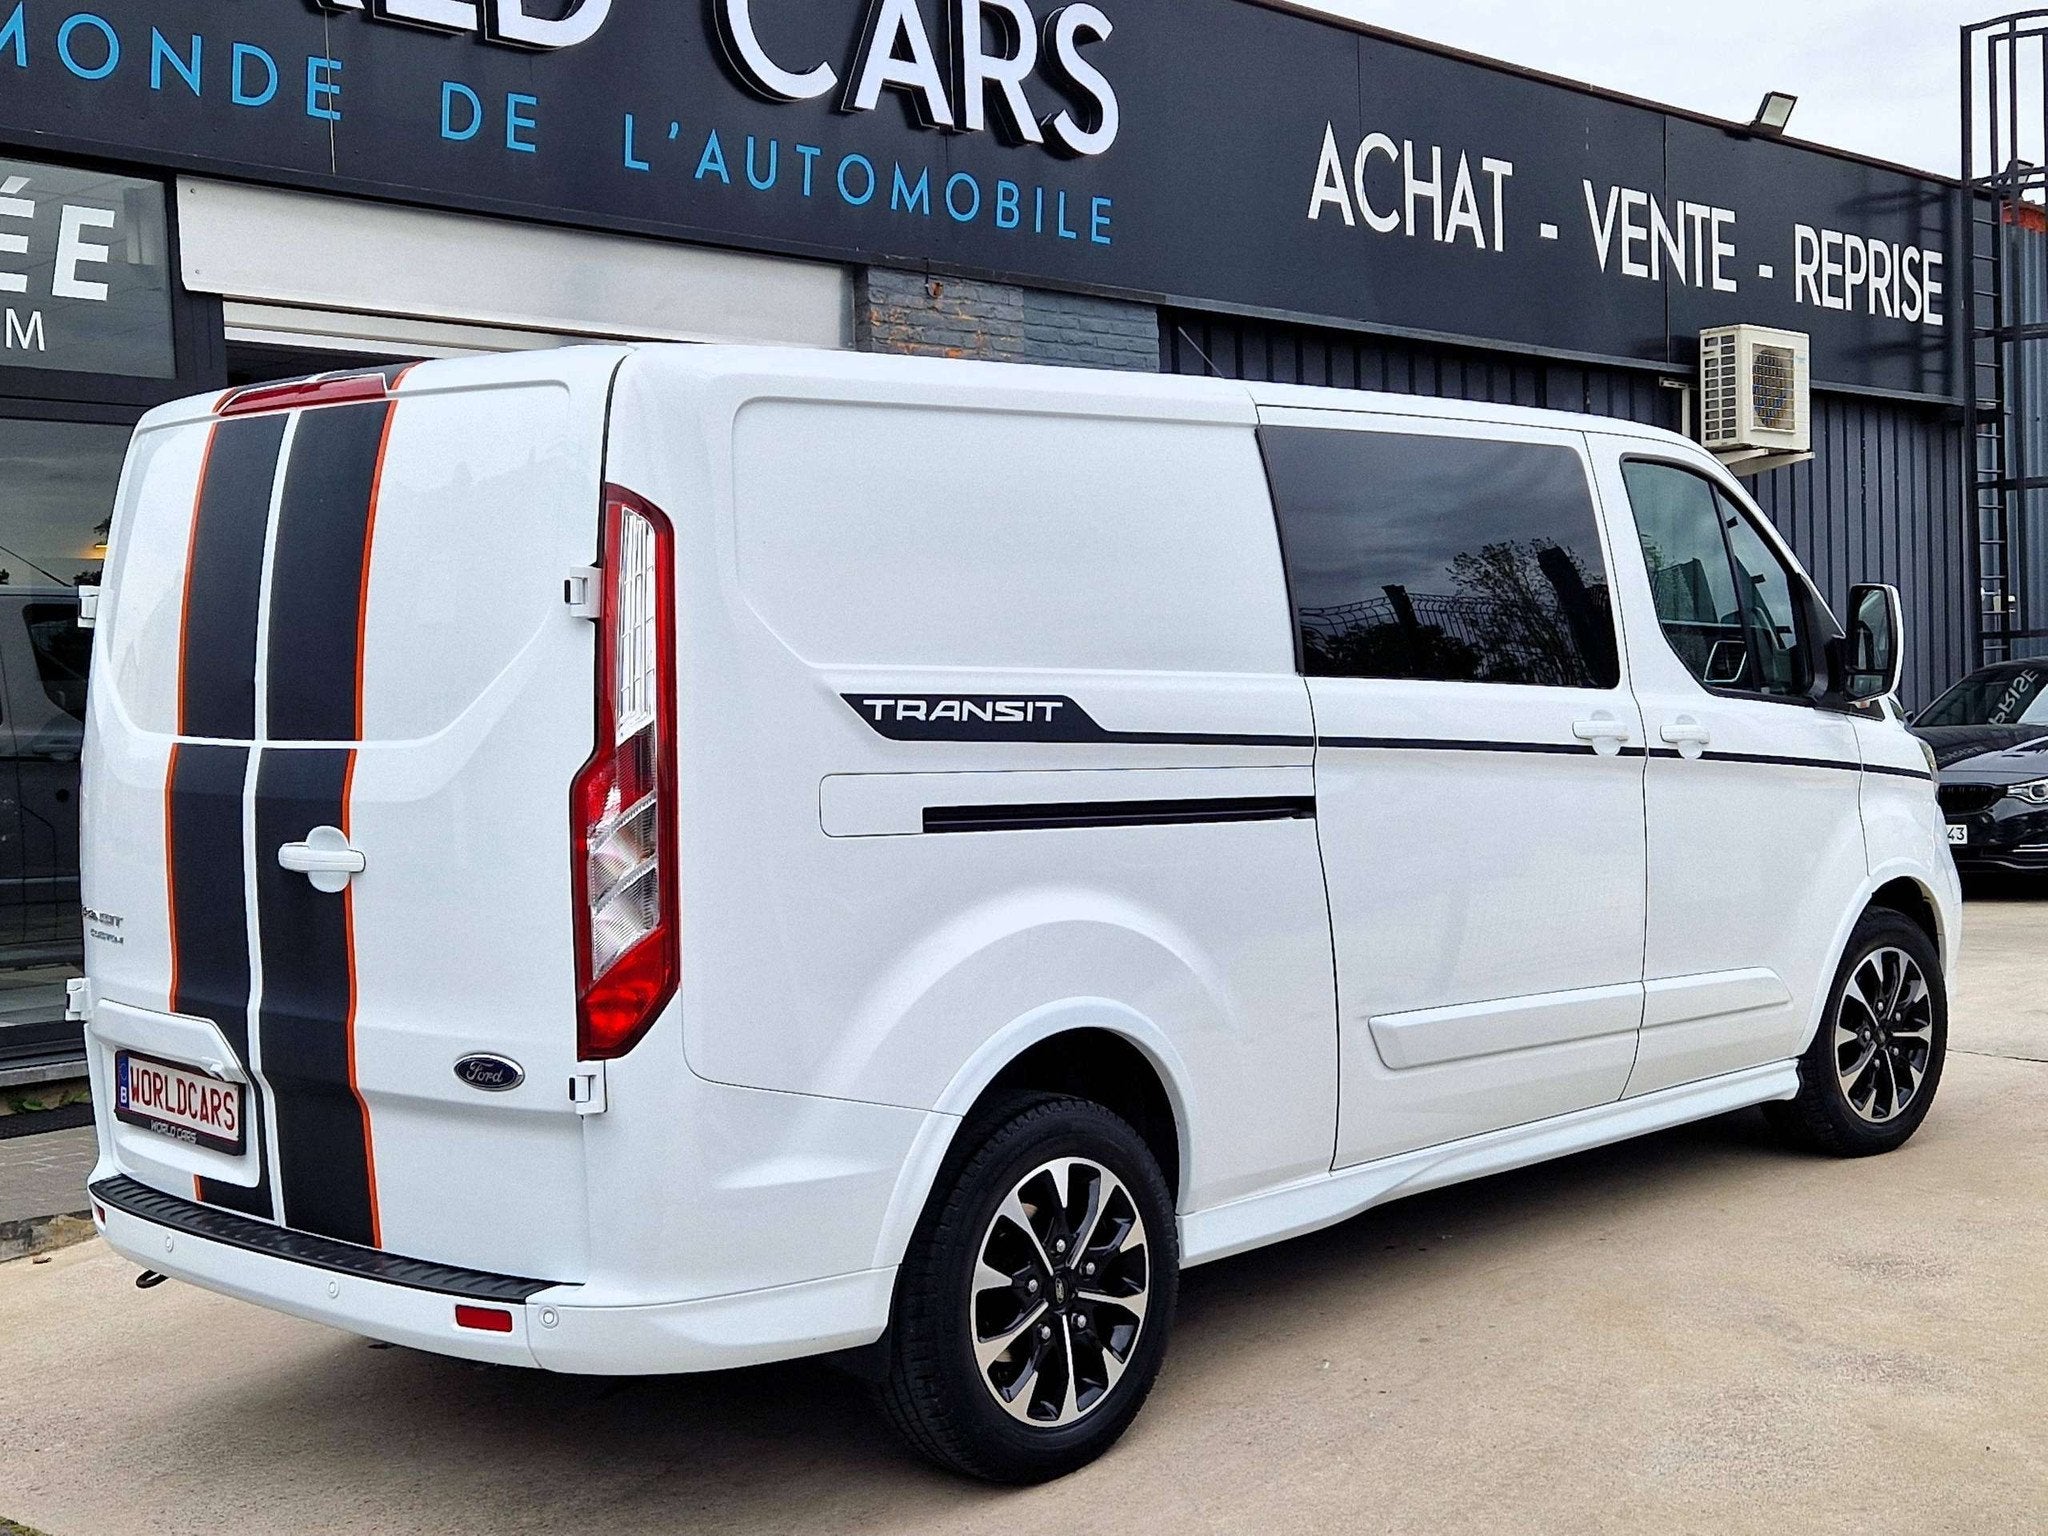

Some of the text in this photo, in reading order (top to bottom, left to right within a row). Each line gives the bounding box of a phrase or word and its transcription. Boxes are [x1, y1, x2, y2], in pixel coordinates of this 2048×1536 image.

[718, 0, 1119, 156] CARS
[441, 82, 538, 153] DE
[1308, 120, 1513, 252] ACHAT
[1583, 179, 1737, 293] VENTE
[1794, 224, 1944, 326] REPRISE
[862, 699, 1064, 723] TRANSIT
[120, 1066, 235, 1131] B WORLDCARS
[466, 1060, 503, 1083] Ford
[150, 1119, 197, 1144] WORLD CARS
